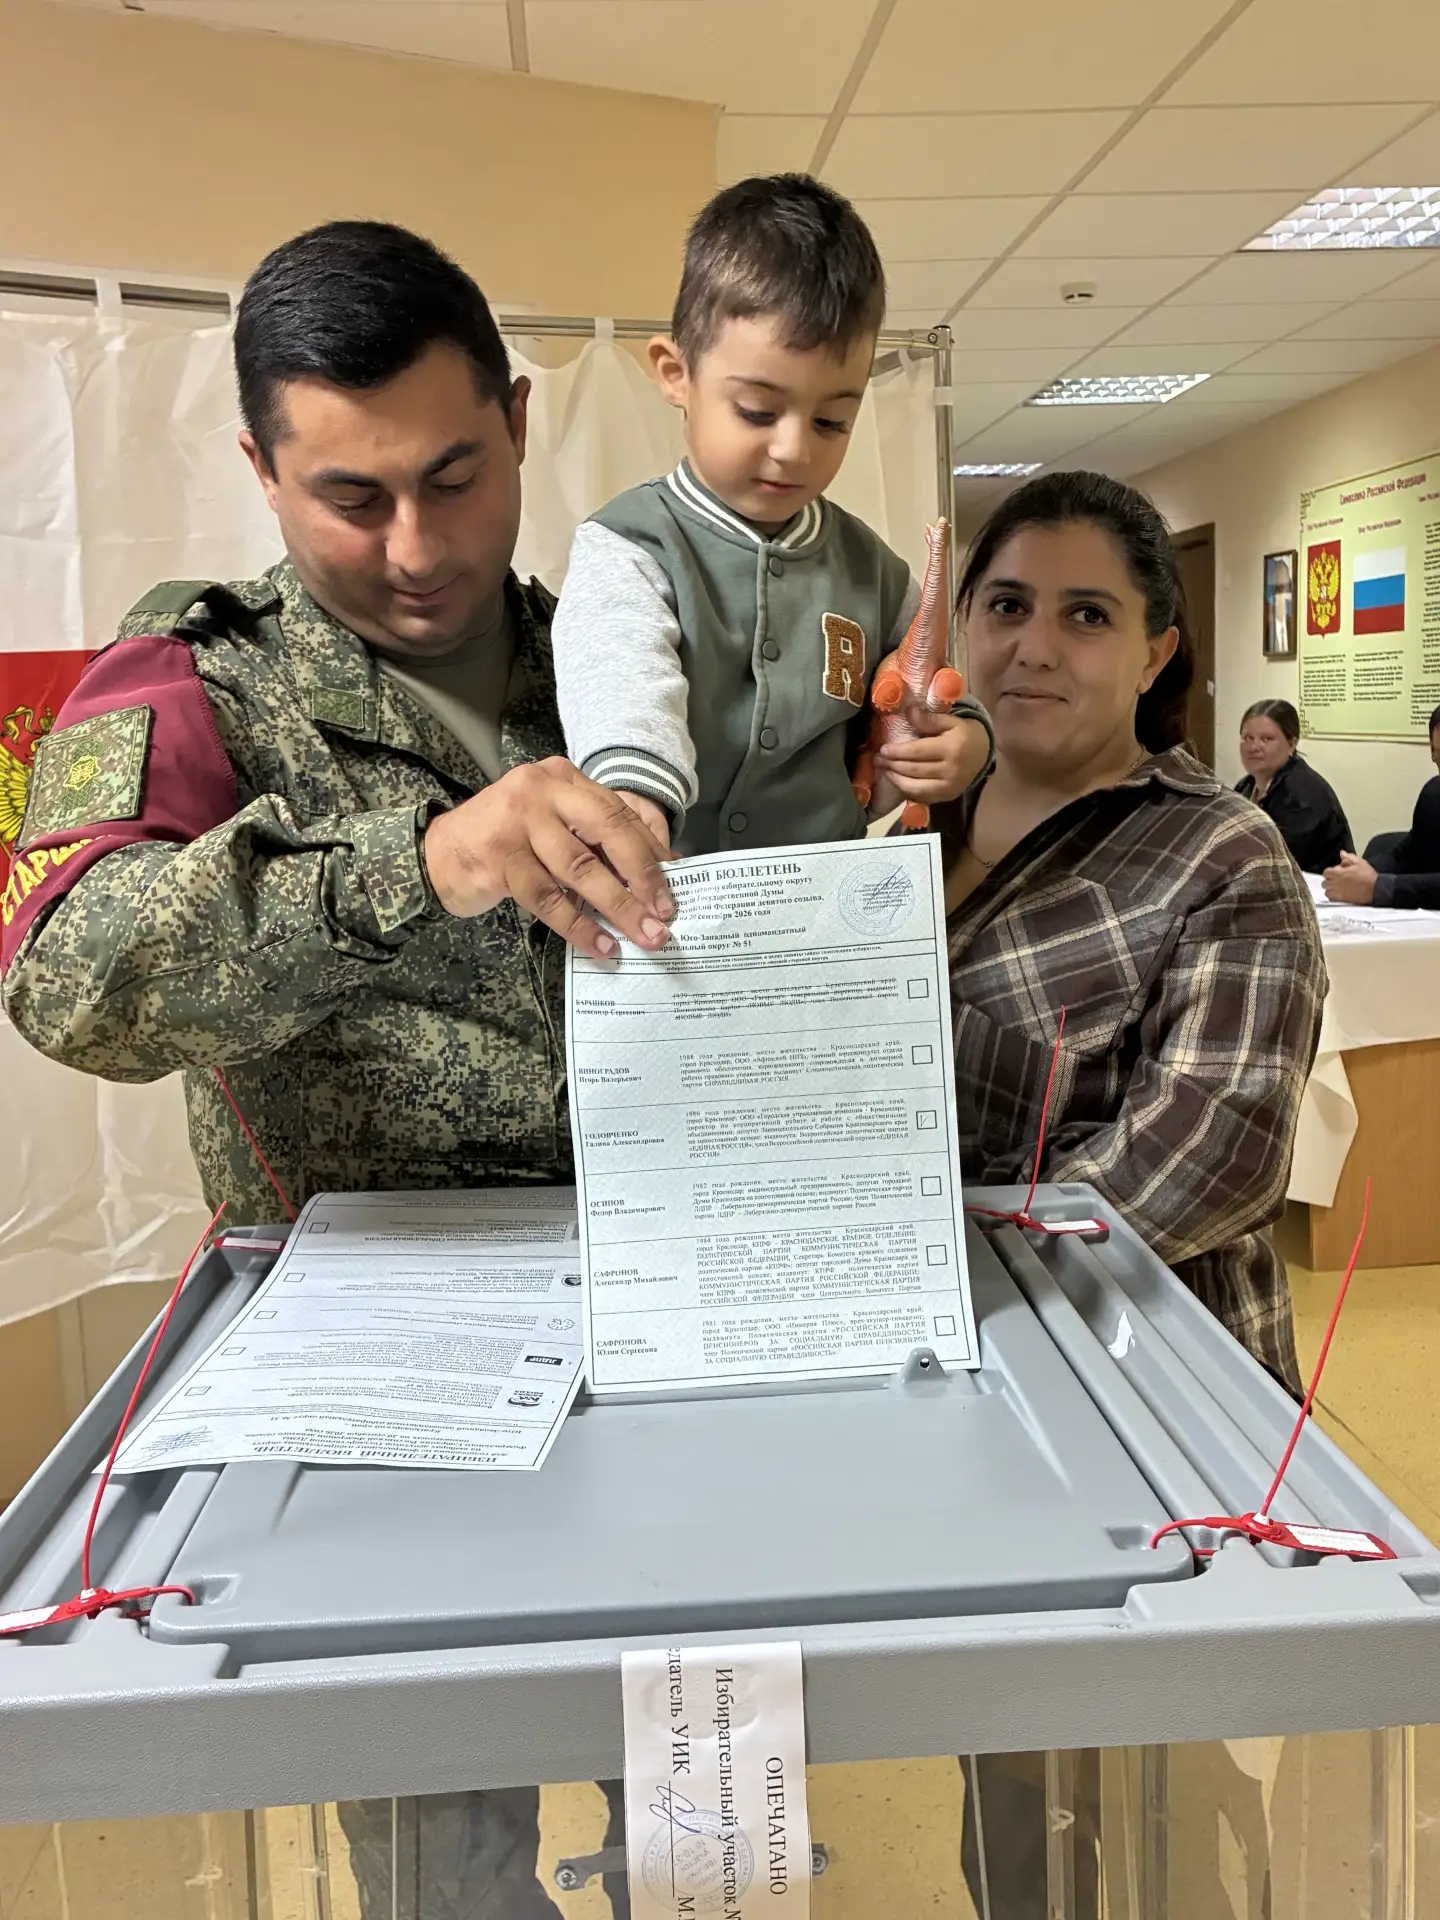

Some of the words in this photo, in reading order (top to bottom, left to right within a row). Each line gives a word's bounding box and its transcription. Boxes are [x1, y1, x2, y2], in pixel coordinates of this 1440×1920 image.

[716, 863, 802, 880] БЮЛЛЕТЕНЬ
[786, 877, 812, 885] округу
[760, 889, 784, 898] Думы
[713, 901, 756, 910] Федерации
[735, 910, 752, 918] 2026
[754, 909, 771, 917] года
[743, 926, 807, 938] одномандатный
[708, 943, 731, 951] округ
[578, 1067, 630, 1075] ВИНОГРАДОВ
[579, 1075, 600, 1084] Игорь
[584, 1130, 639, 1140] ГОЛОВЧЕНКО
[590, 1199, 625, 1208] ОСИПОВ
[801, 1240, 879, 1252] КОММУНИСТИЧЕСКАЯ
[887, 1238, 917, 1246] ПАРТИЯ
[593, 1268, 639, 1278] САФРОНОВ
[784, 1276, 815, 1284] ПАРТИЯ
[818, 1272, 869, 1281] РОССИЙСКОЙ
[593, 1277, 633, 1287] Александр
[633, 1274, 678, 1285] Михайлович
[893, 1321, 927, 1329] ПАРТИЯ
[596, 1338, 647, 1348] САФРОНОВА
[596, 1347, 620, 1356] Юлия
[253, 1446, 353, 1457] БЮЛЛЕТЕНЬ
[359, 1450, 498, 1463] ИЗБИРАТЕЛЬНЫЙ
[671, 1724, 691, 1775] УИК
[712, 1667, 739, 1829] Избирательный
[765, 1756, 788, 1896] ОПЕЧАТАНО
[717, 1832, 738, 1905] участок
